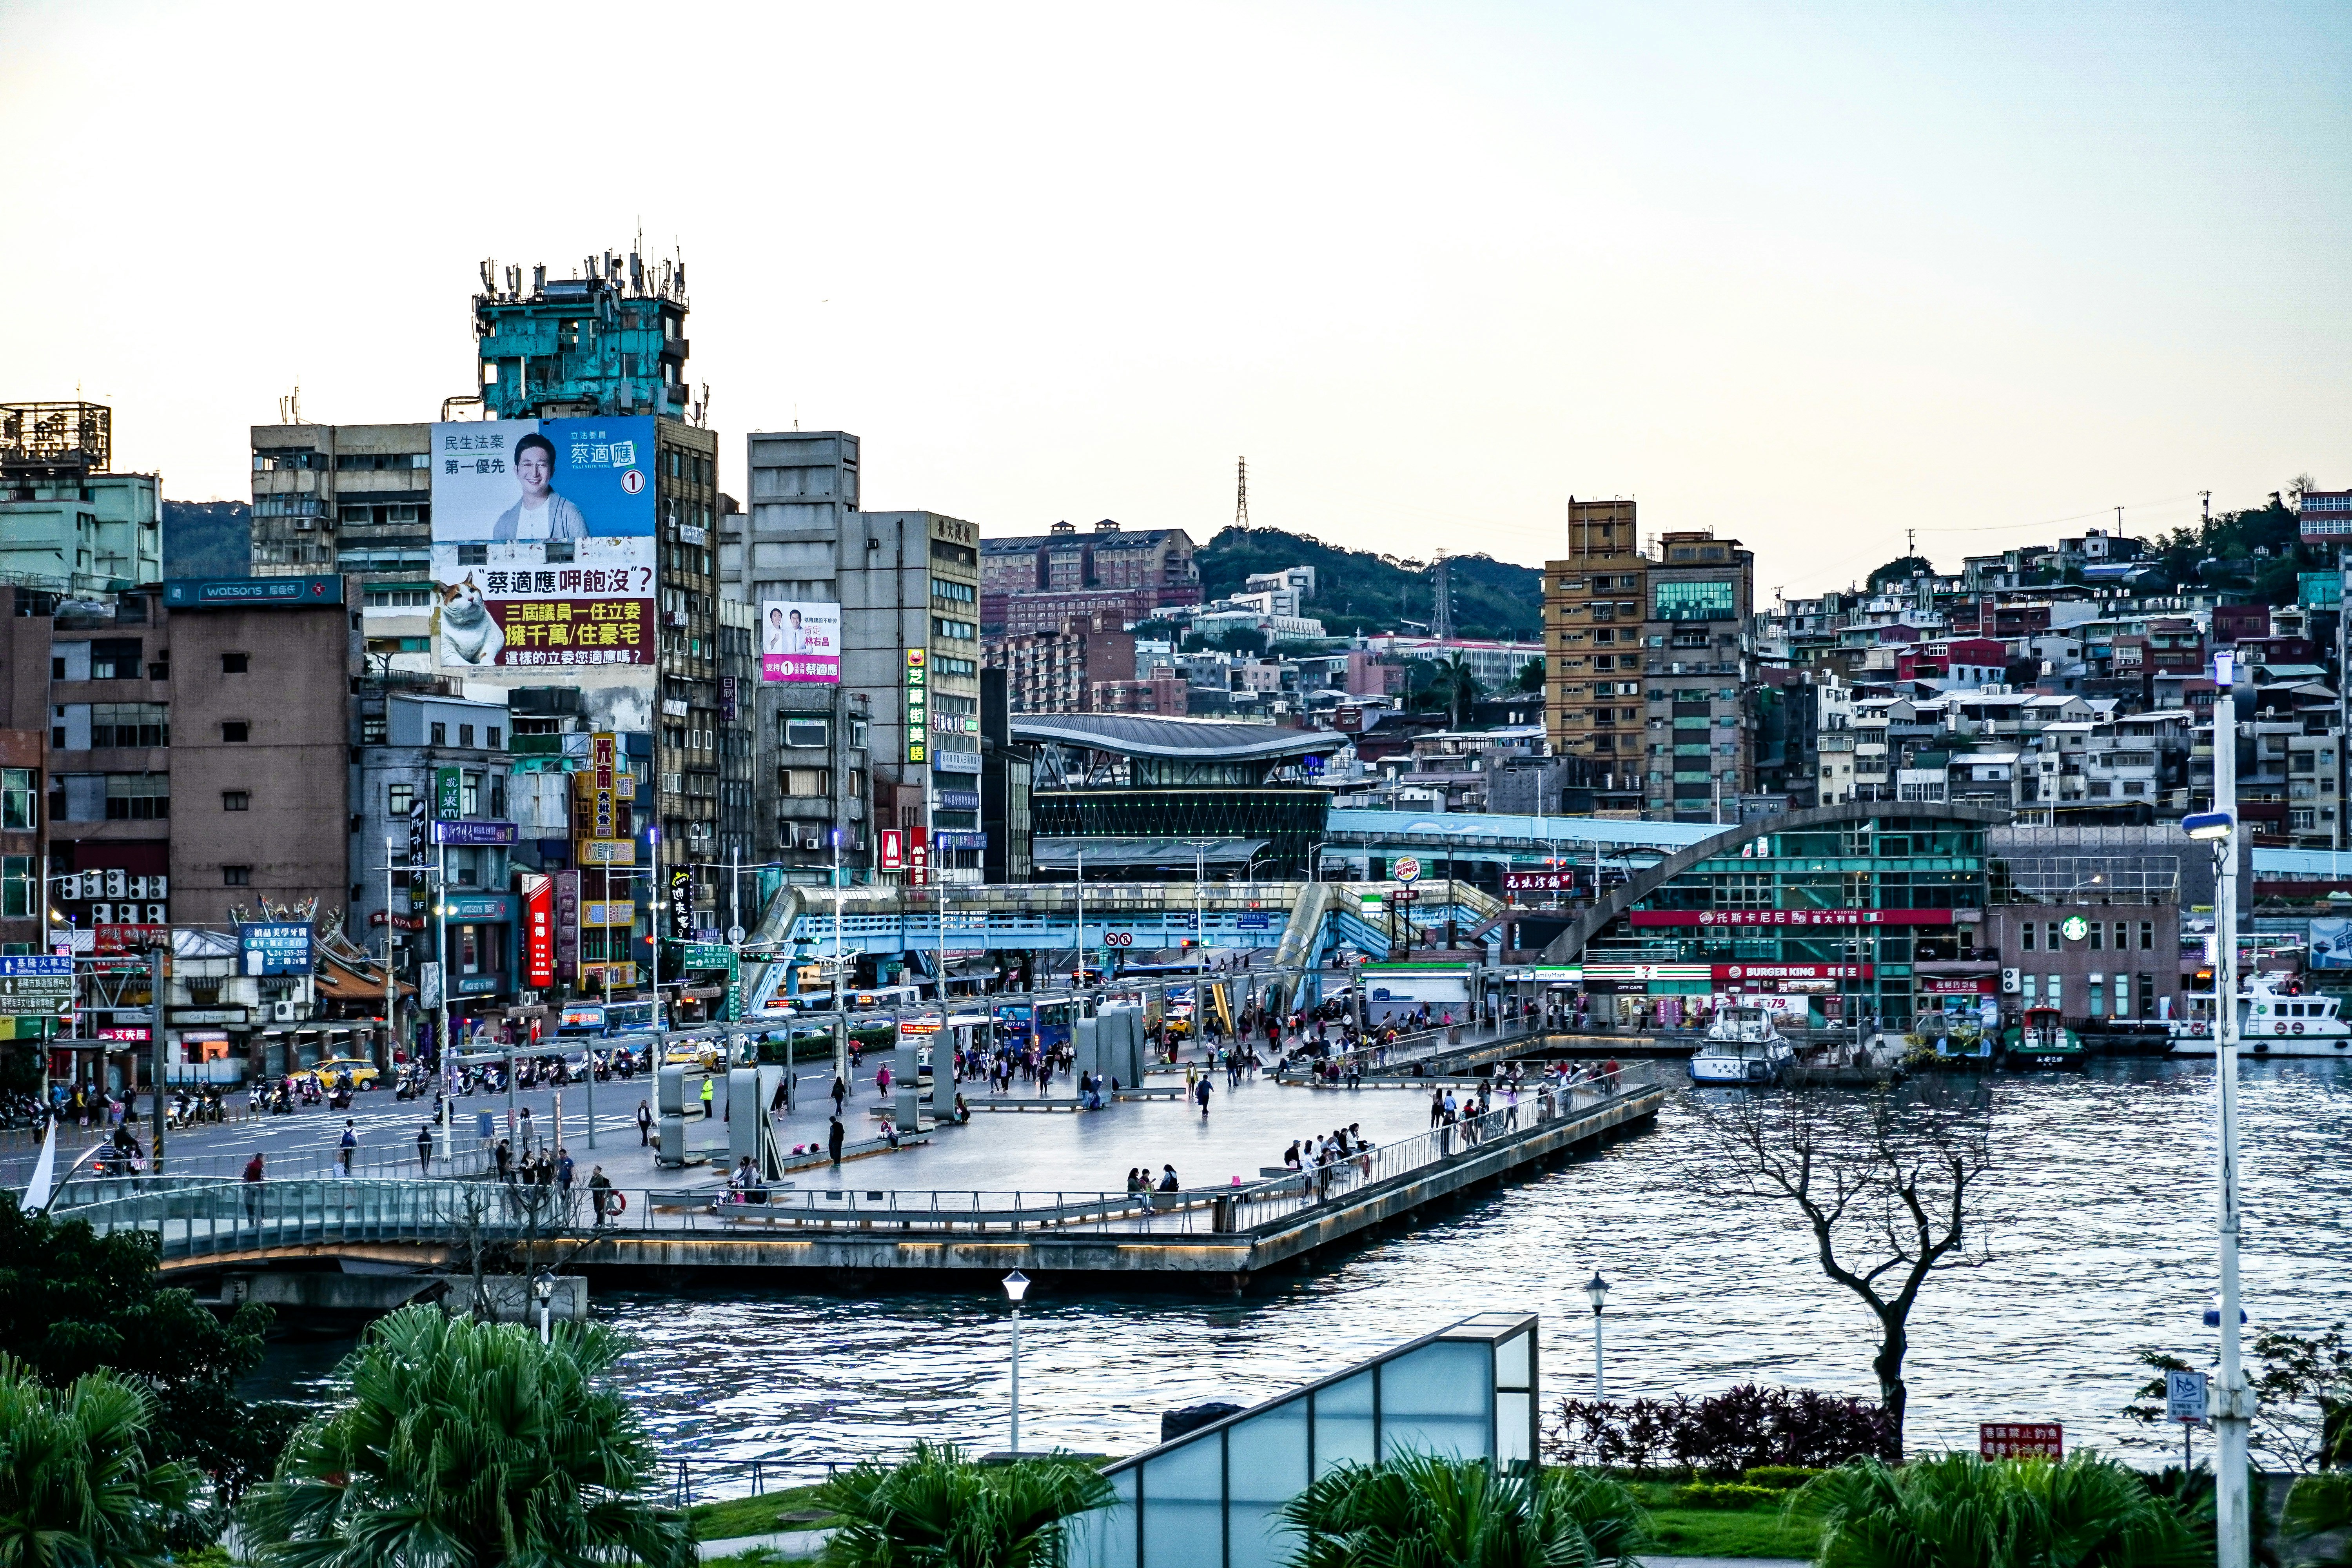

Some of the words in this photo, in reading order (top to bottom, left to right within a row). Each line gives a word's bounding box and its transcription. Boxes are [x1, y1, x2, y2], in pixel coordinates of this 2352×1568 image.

[571, 431, 606, 440] 立法委員
[445, 434, 504, 451] 民生法案
[571, 442, 633, 466] 蔡適應
[445, 458, 505, 475] 第一優先
[628, 473, 636, 490] 1
[207, 587, 262, 596] watsons
[505, 603, 641, 622] 三屆議員一任立委
[505, 622, 641, 646] 擁千萬/住豪宅
[804, 626, 821, 635] 肯定
[805, 637, 829, 646] 林右昌
[765, 663, 780, 672] 支持
[785, 663, 789, 674] 1
[806, 662, 838, 676] 蔡適應
[441, 809, 458, 818] KTV
[1396, 860, 1416, 870] BURGER
[1397, 865, 1417, 877] KING
[393, 917, 411, 928] SPA
[1717, 912, 1785, 923] 托斯卡尼尼
[17, 958, 70, 968] 基隆火車站
[1746, 967, 1787, 976] BURGER
[1789, 967, 1815, 976] KING
[1984, 1427, 2058, 1439] 港區禁止釣魚
